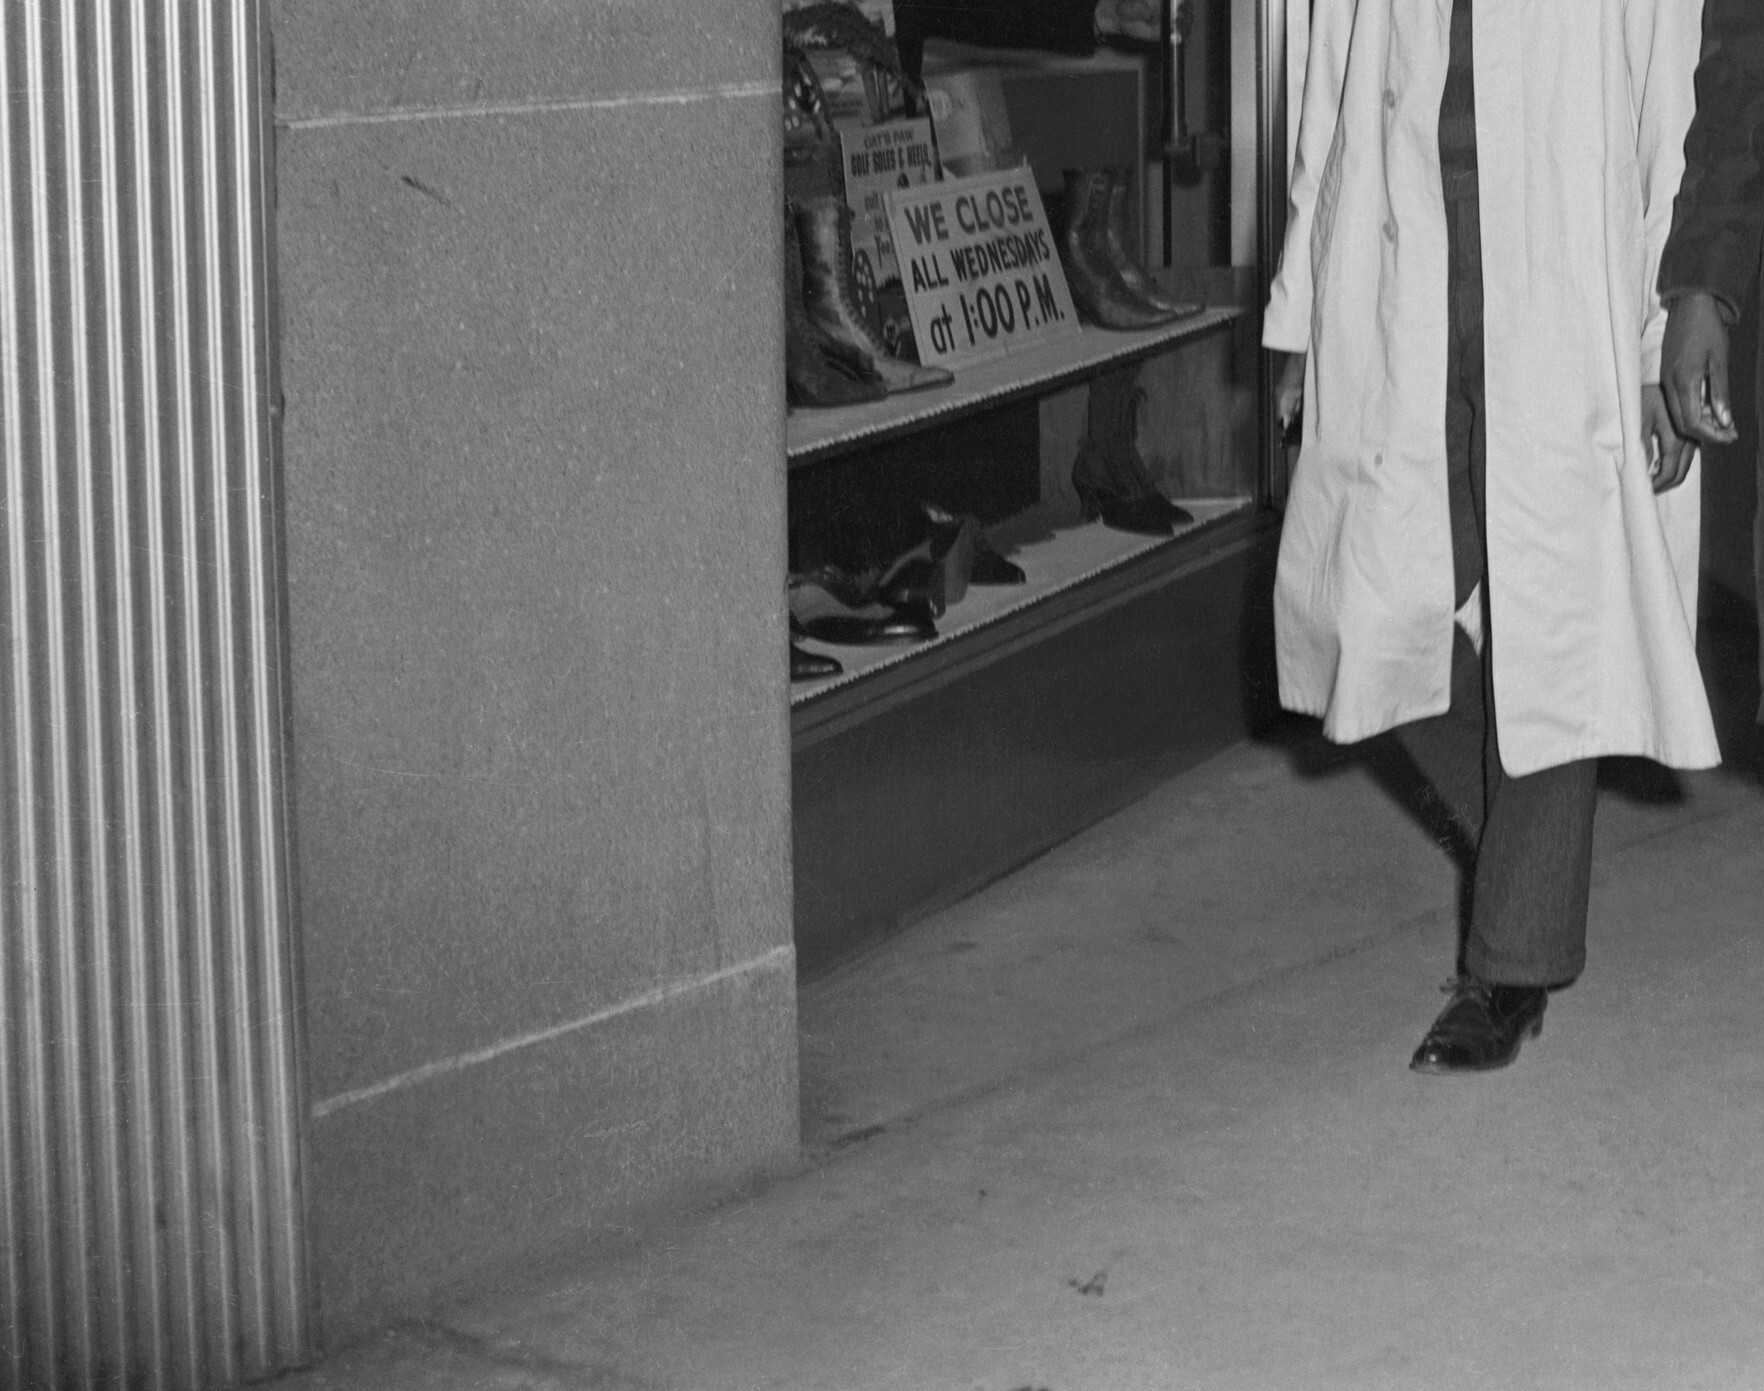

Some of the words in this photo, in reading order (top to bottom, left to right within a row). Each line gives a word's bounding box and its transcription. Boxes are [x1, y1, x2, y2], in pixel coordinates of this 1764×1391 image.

[904, 201, 949, 245] WE
[955, 185, 1034, 235] CLOSE
[911, 253, 950, 293] ALL
[950, 228, 1051, 282] WEDNESDAYS
[930, 303, 956, 355] at
[959, 283, 1016, 347] 1:00
[1015, 273, 1065, 330] P.M.
